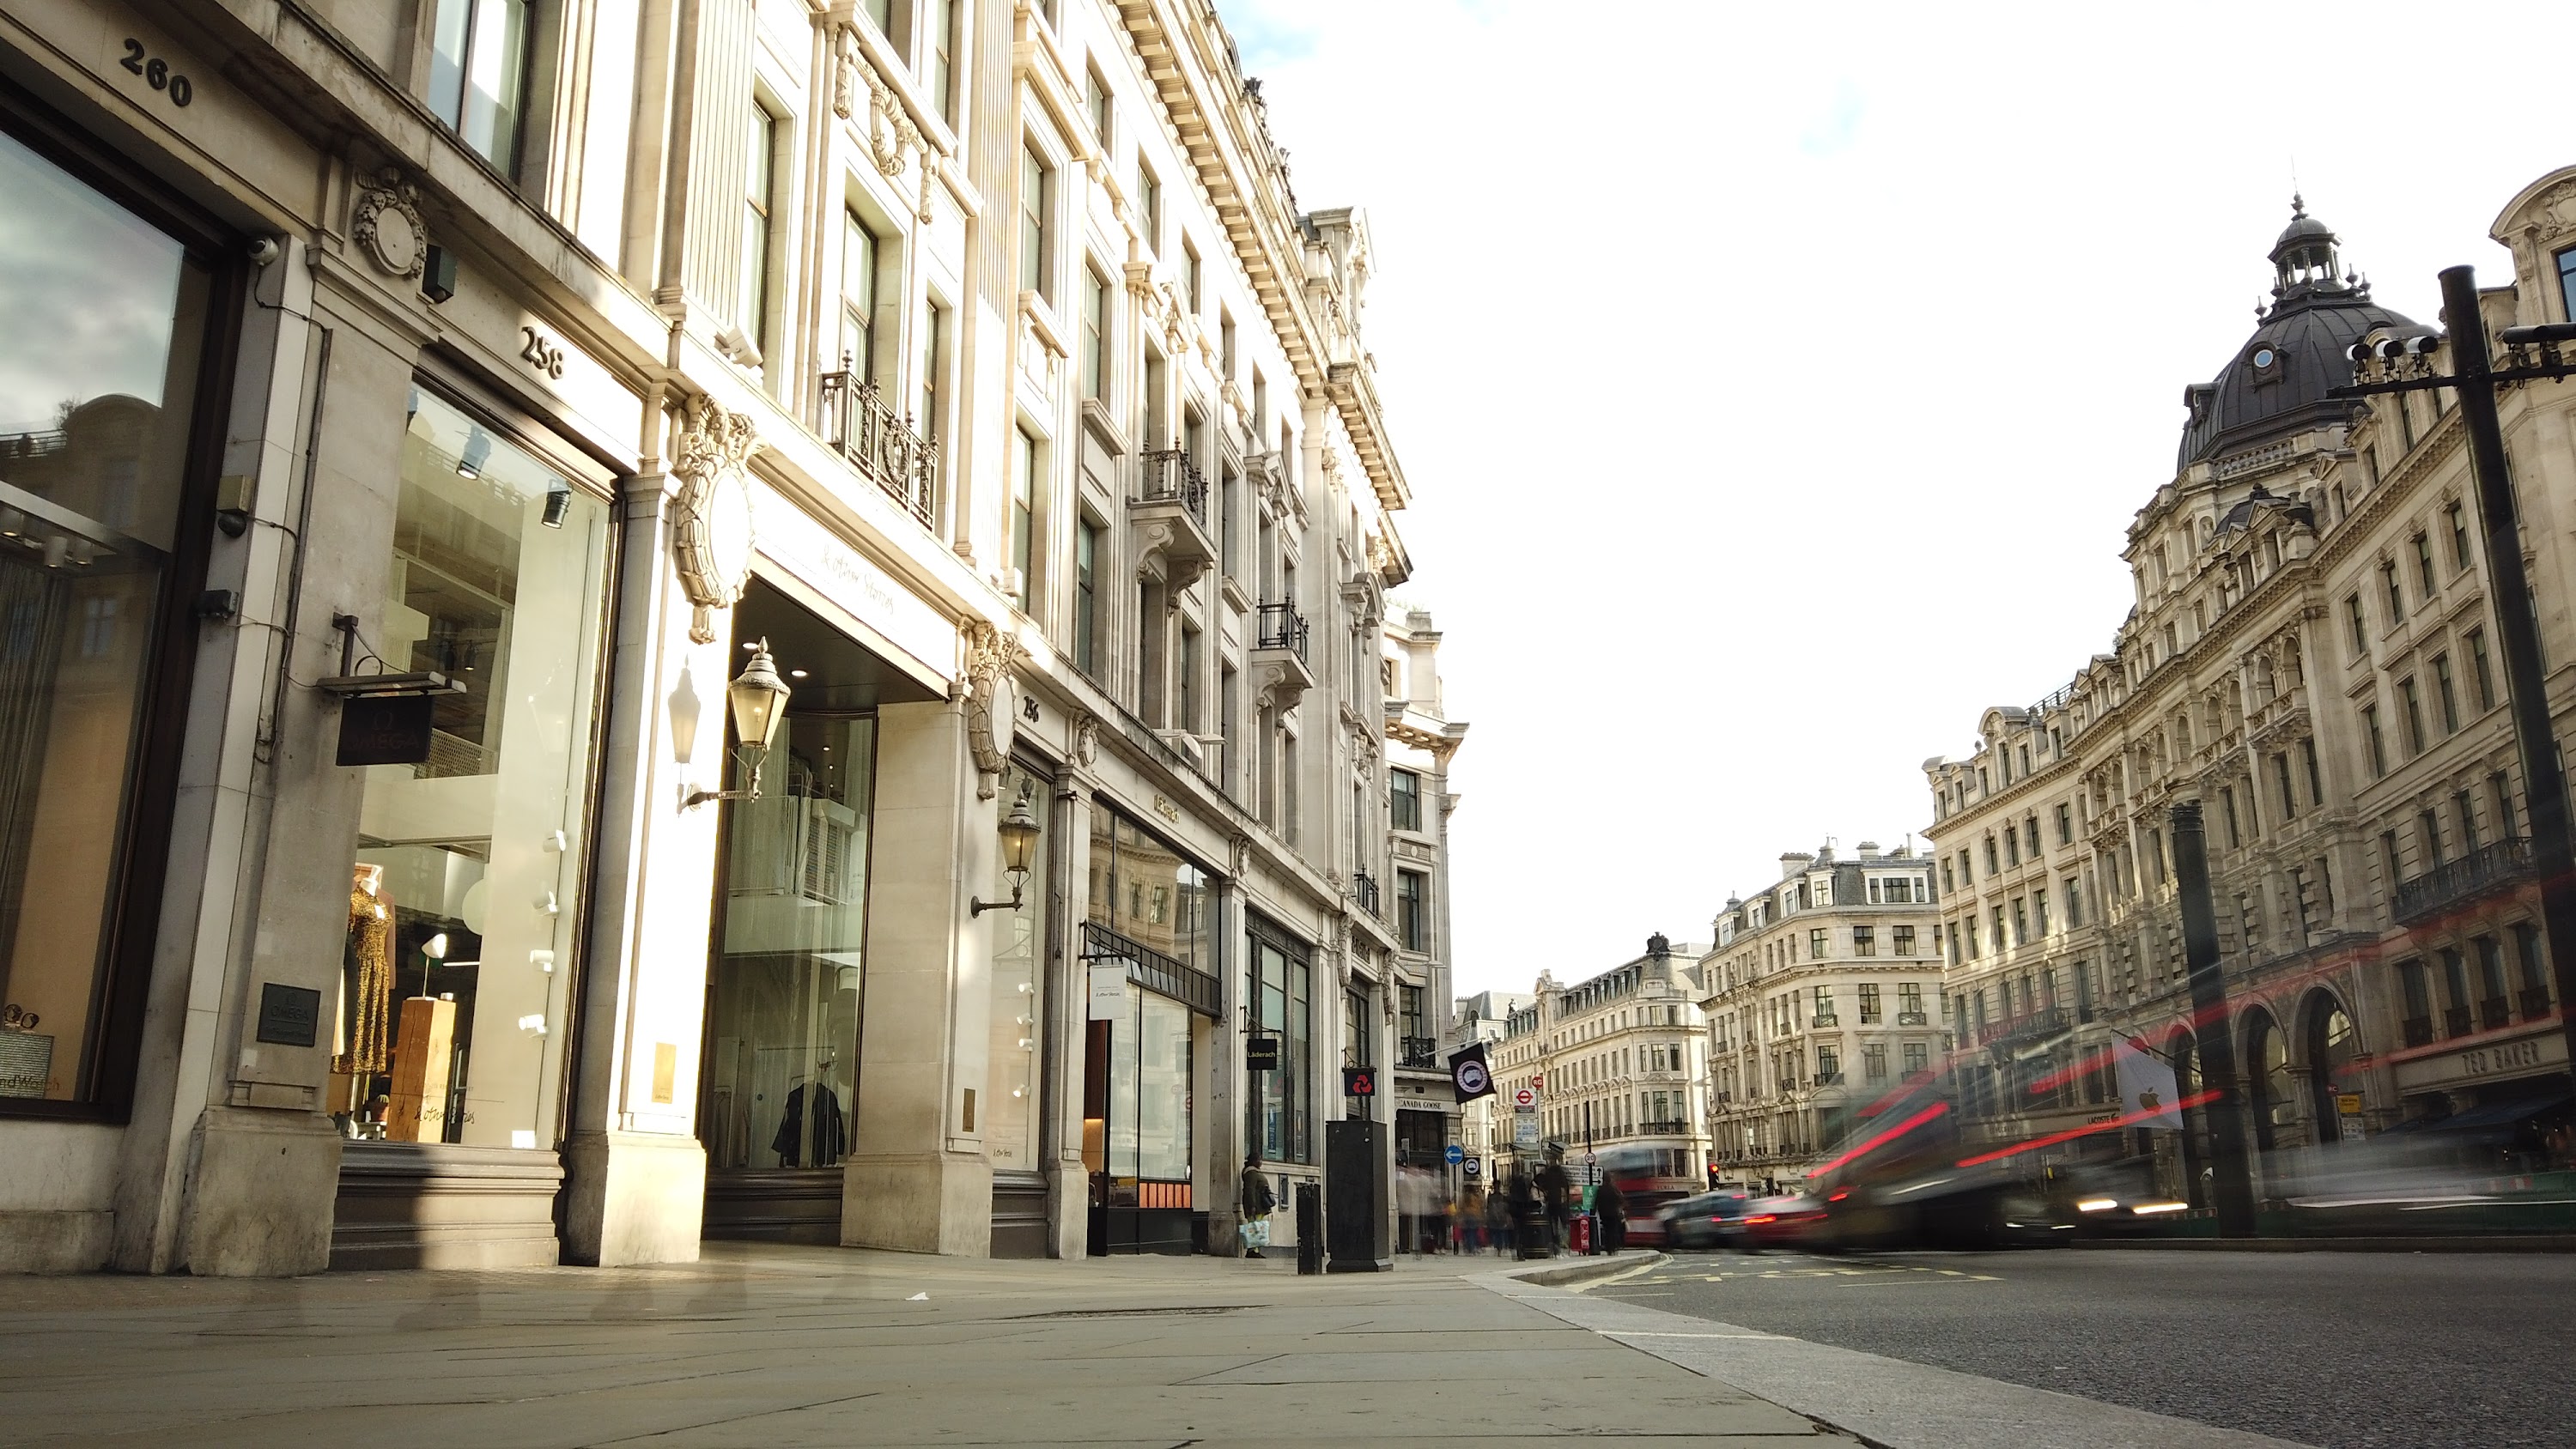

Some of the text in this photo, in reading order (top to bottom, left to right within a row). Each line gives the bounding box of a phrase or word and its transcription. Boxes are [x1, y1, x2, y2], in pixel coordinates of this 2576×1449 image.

[120, 38, 192, 107] 260
[520, 326, 565, 380] 258
[270, 1003, 309, 1021] OMEGA
[2462, 1040, 2539, 1074] TED BAKER
[1423, 1101, 1442, 1110] GOOSE
[2087, 1115, 2111, 1125] LACOSTE
